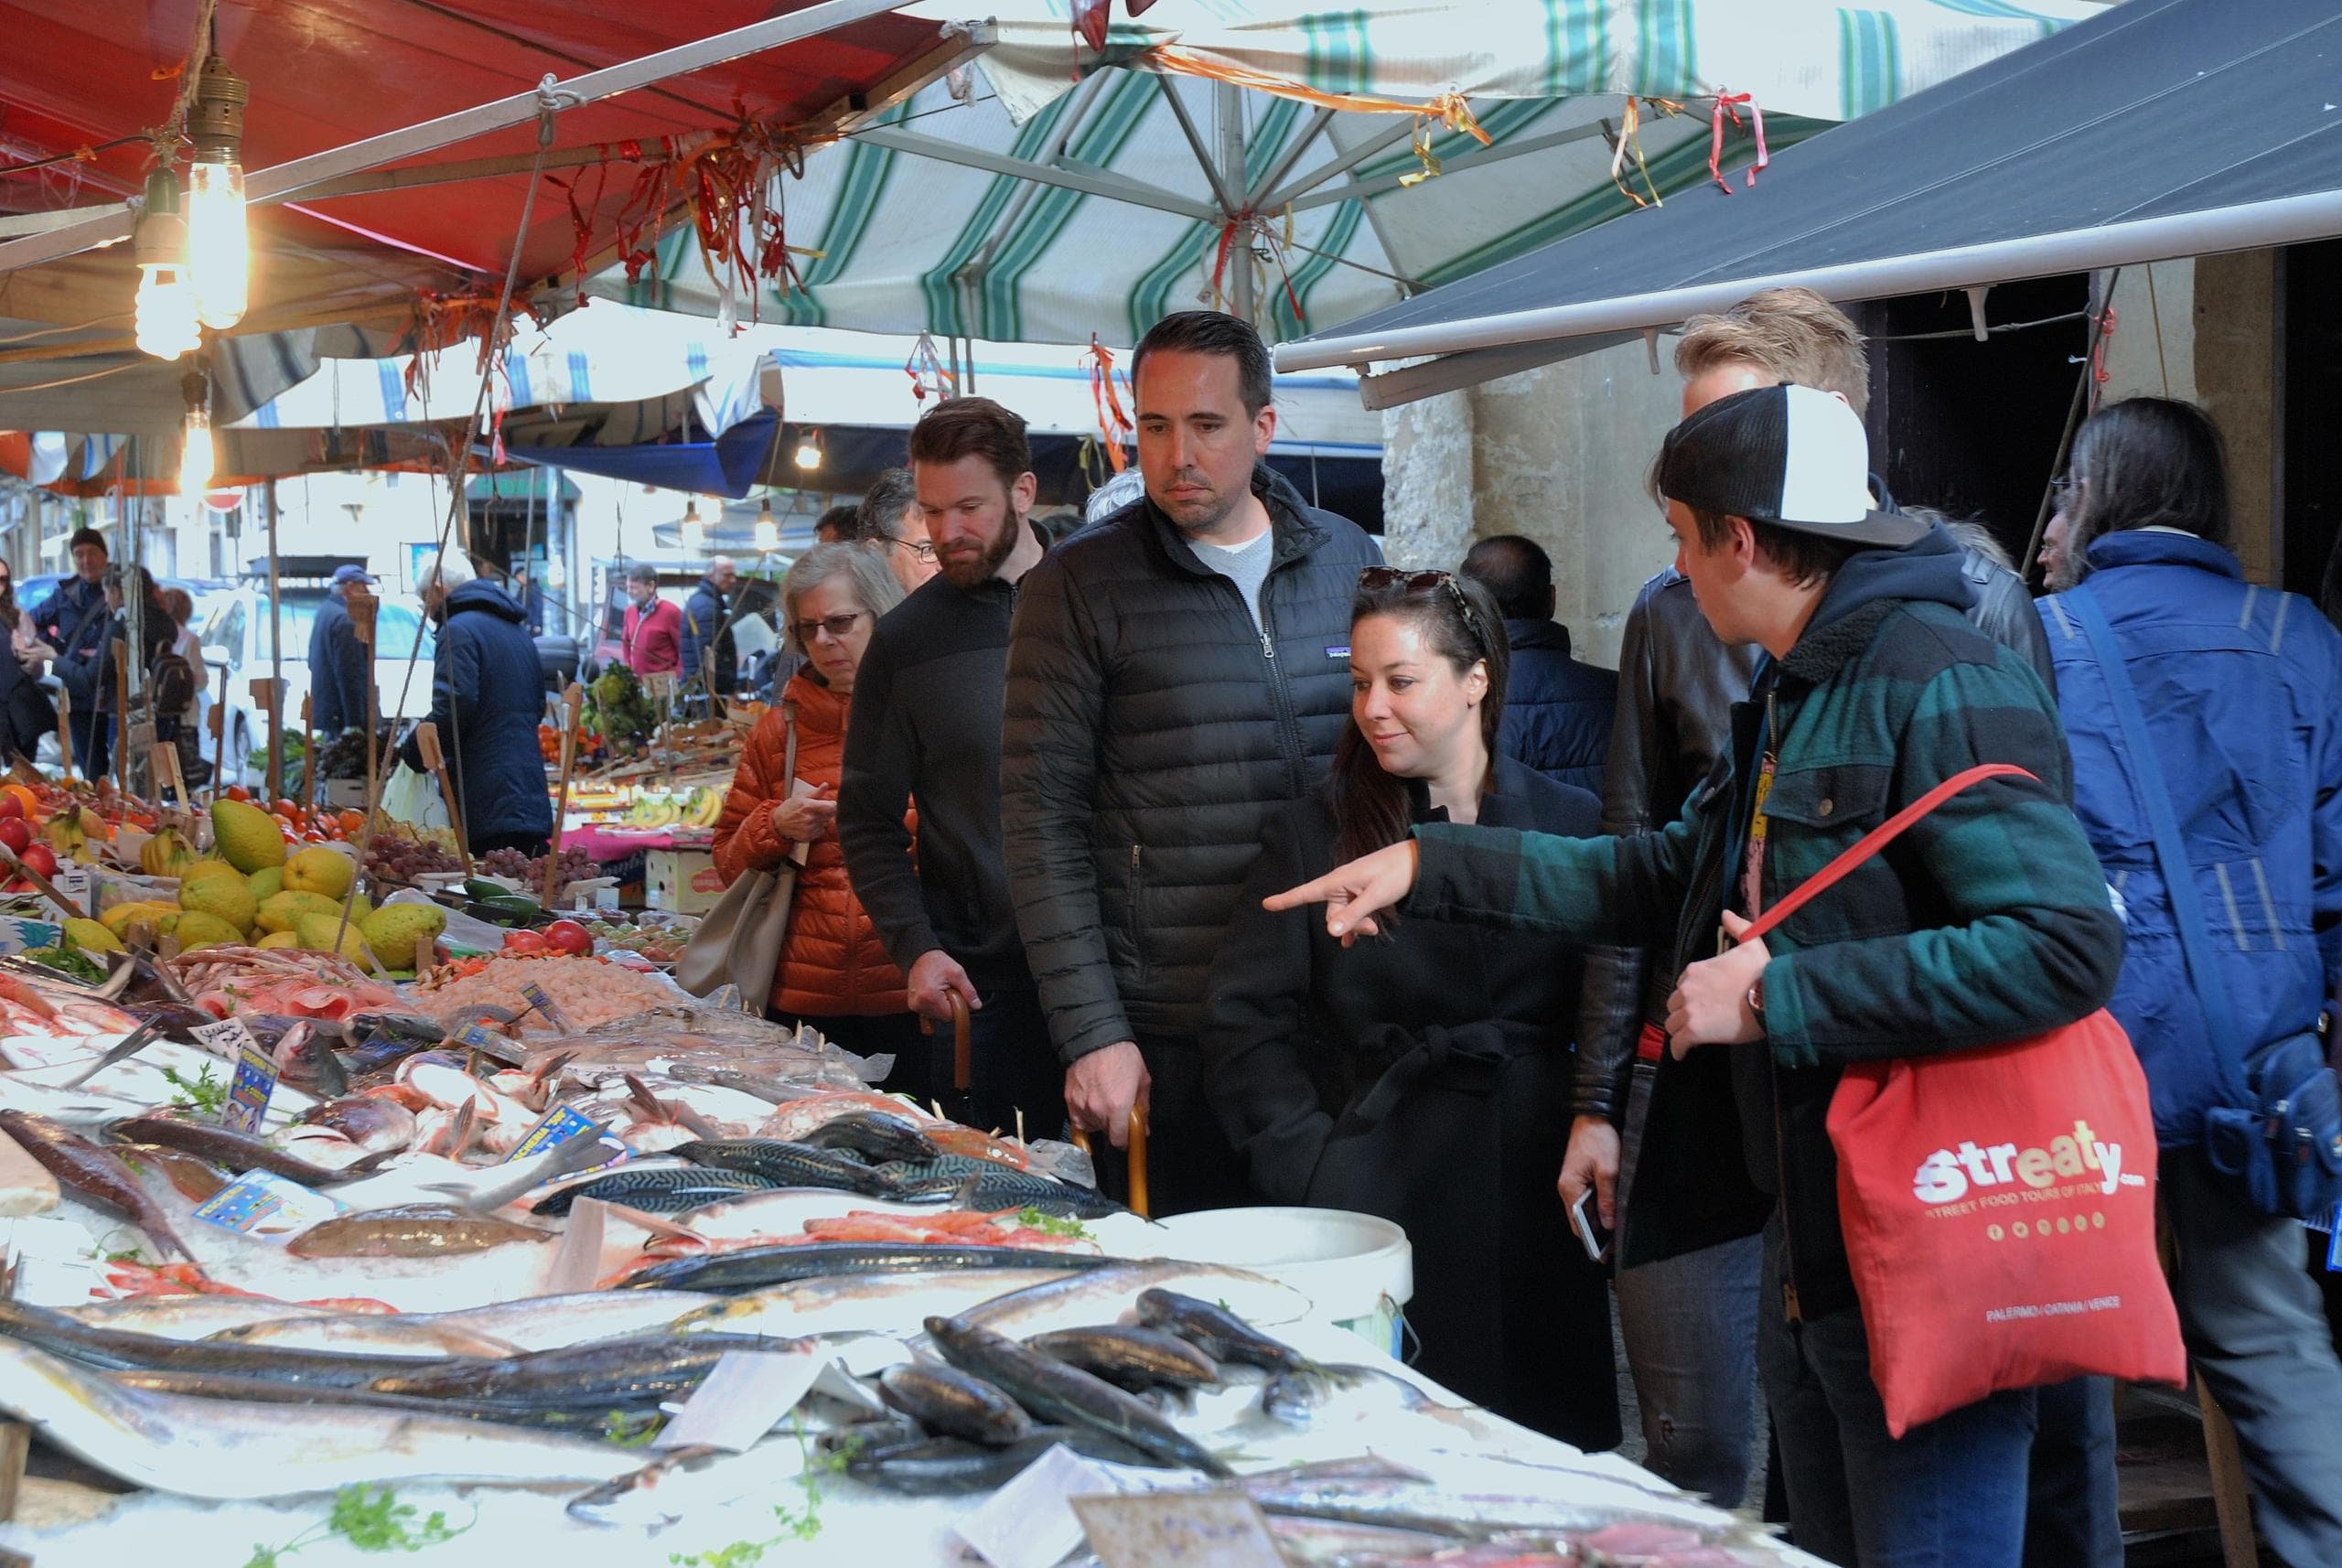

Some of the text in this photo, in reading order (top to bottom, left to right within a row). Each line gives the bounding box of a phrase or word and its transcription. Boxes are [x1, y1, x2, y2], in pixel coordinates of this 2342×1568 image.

[1925, 1201, 1978, 1219] STREET
[1979, 1192, 2019, 1208] FOOD
[2020, 1187, 2061, 1203] TOURS
[2061, 1184, 2076, 1197] OF
